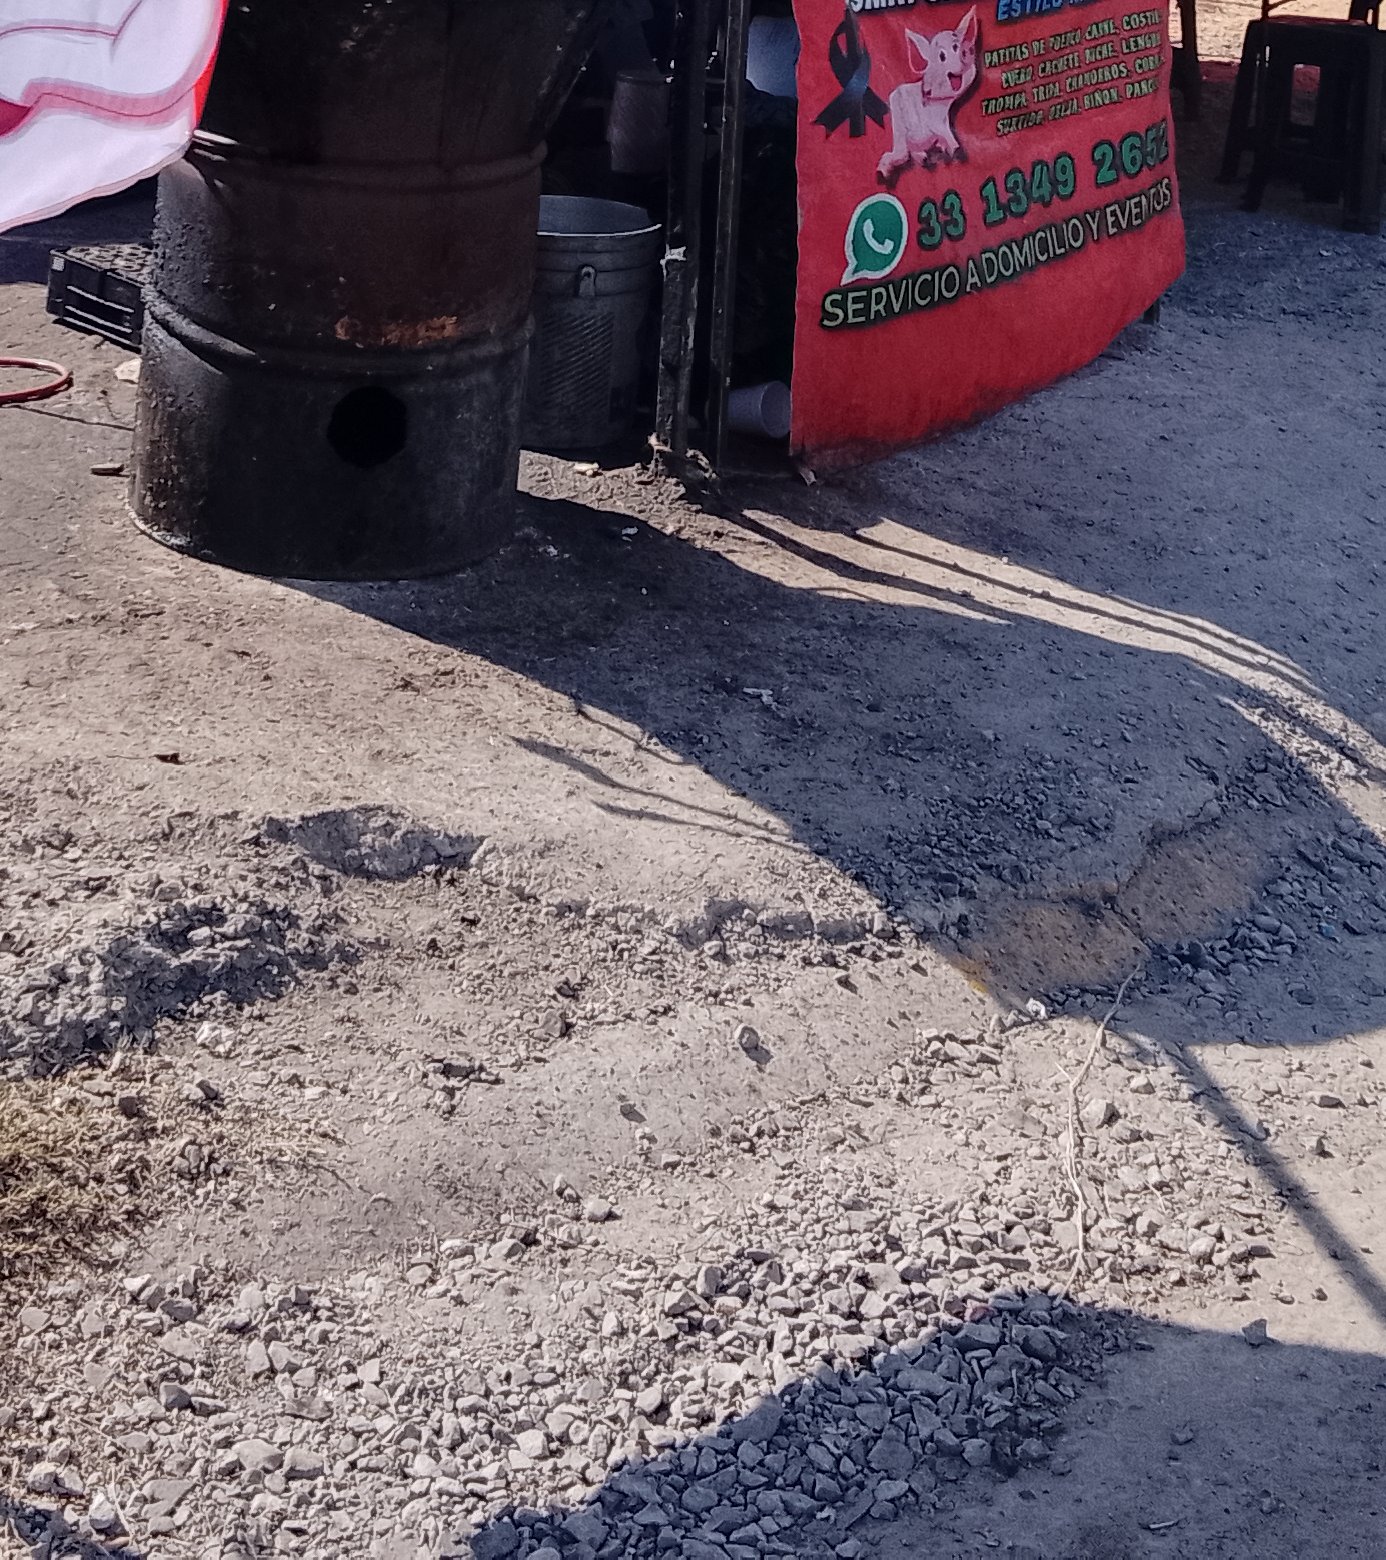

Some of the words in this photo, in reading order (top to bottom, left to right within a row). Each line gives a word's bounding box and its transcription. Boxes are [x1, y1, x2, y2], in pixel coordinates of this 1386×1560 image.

[919, 191, 966, 247] 33
[981, 154, 1076, 226] 1349
[822, 268, 960, 328] SERVICIO
[965, 261, 981, 291] A
[982, 218, 1085, 284] DOMICILIO
[1085, 209, 1101, 241] Y
